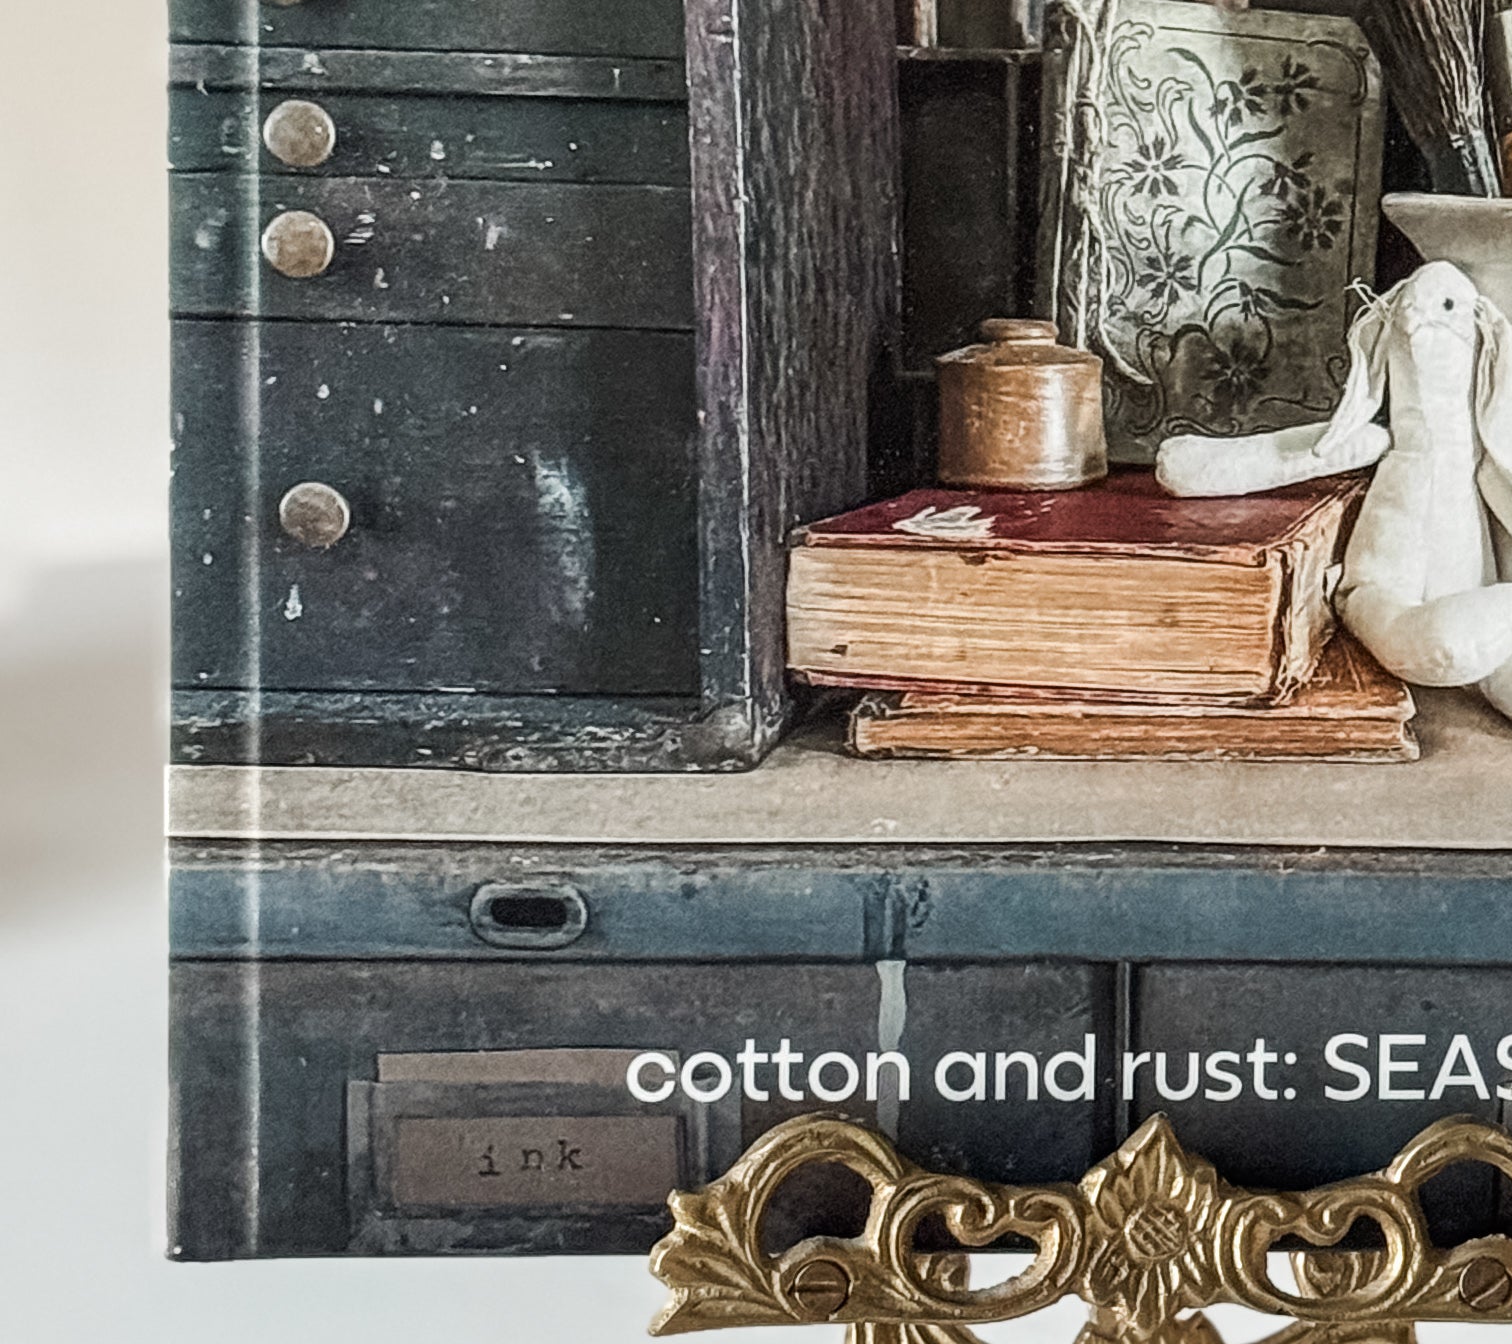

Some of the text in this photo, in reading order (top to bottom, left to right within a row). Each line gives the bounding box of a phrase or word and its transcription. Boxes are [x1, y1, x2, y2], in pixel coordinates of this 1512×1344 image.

[625, 1037, 911, 1103] cotton
[933, 1032, 1097, 1102] and
[1122, 1037, 1298, 1101] rust:
[478, 1139, 584, 1177] ink
